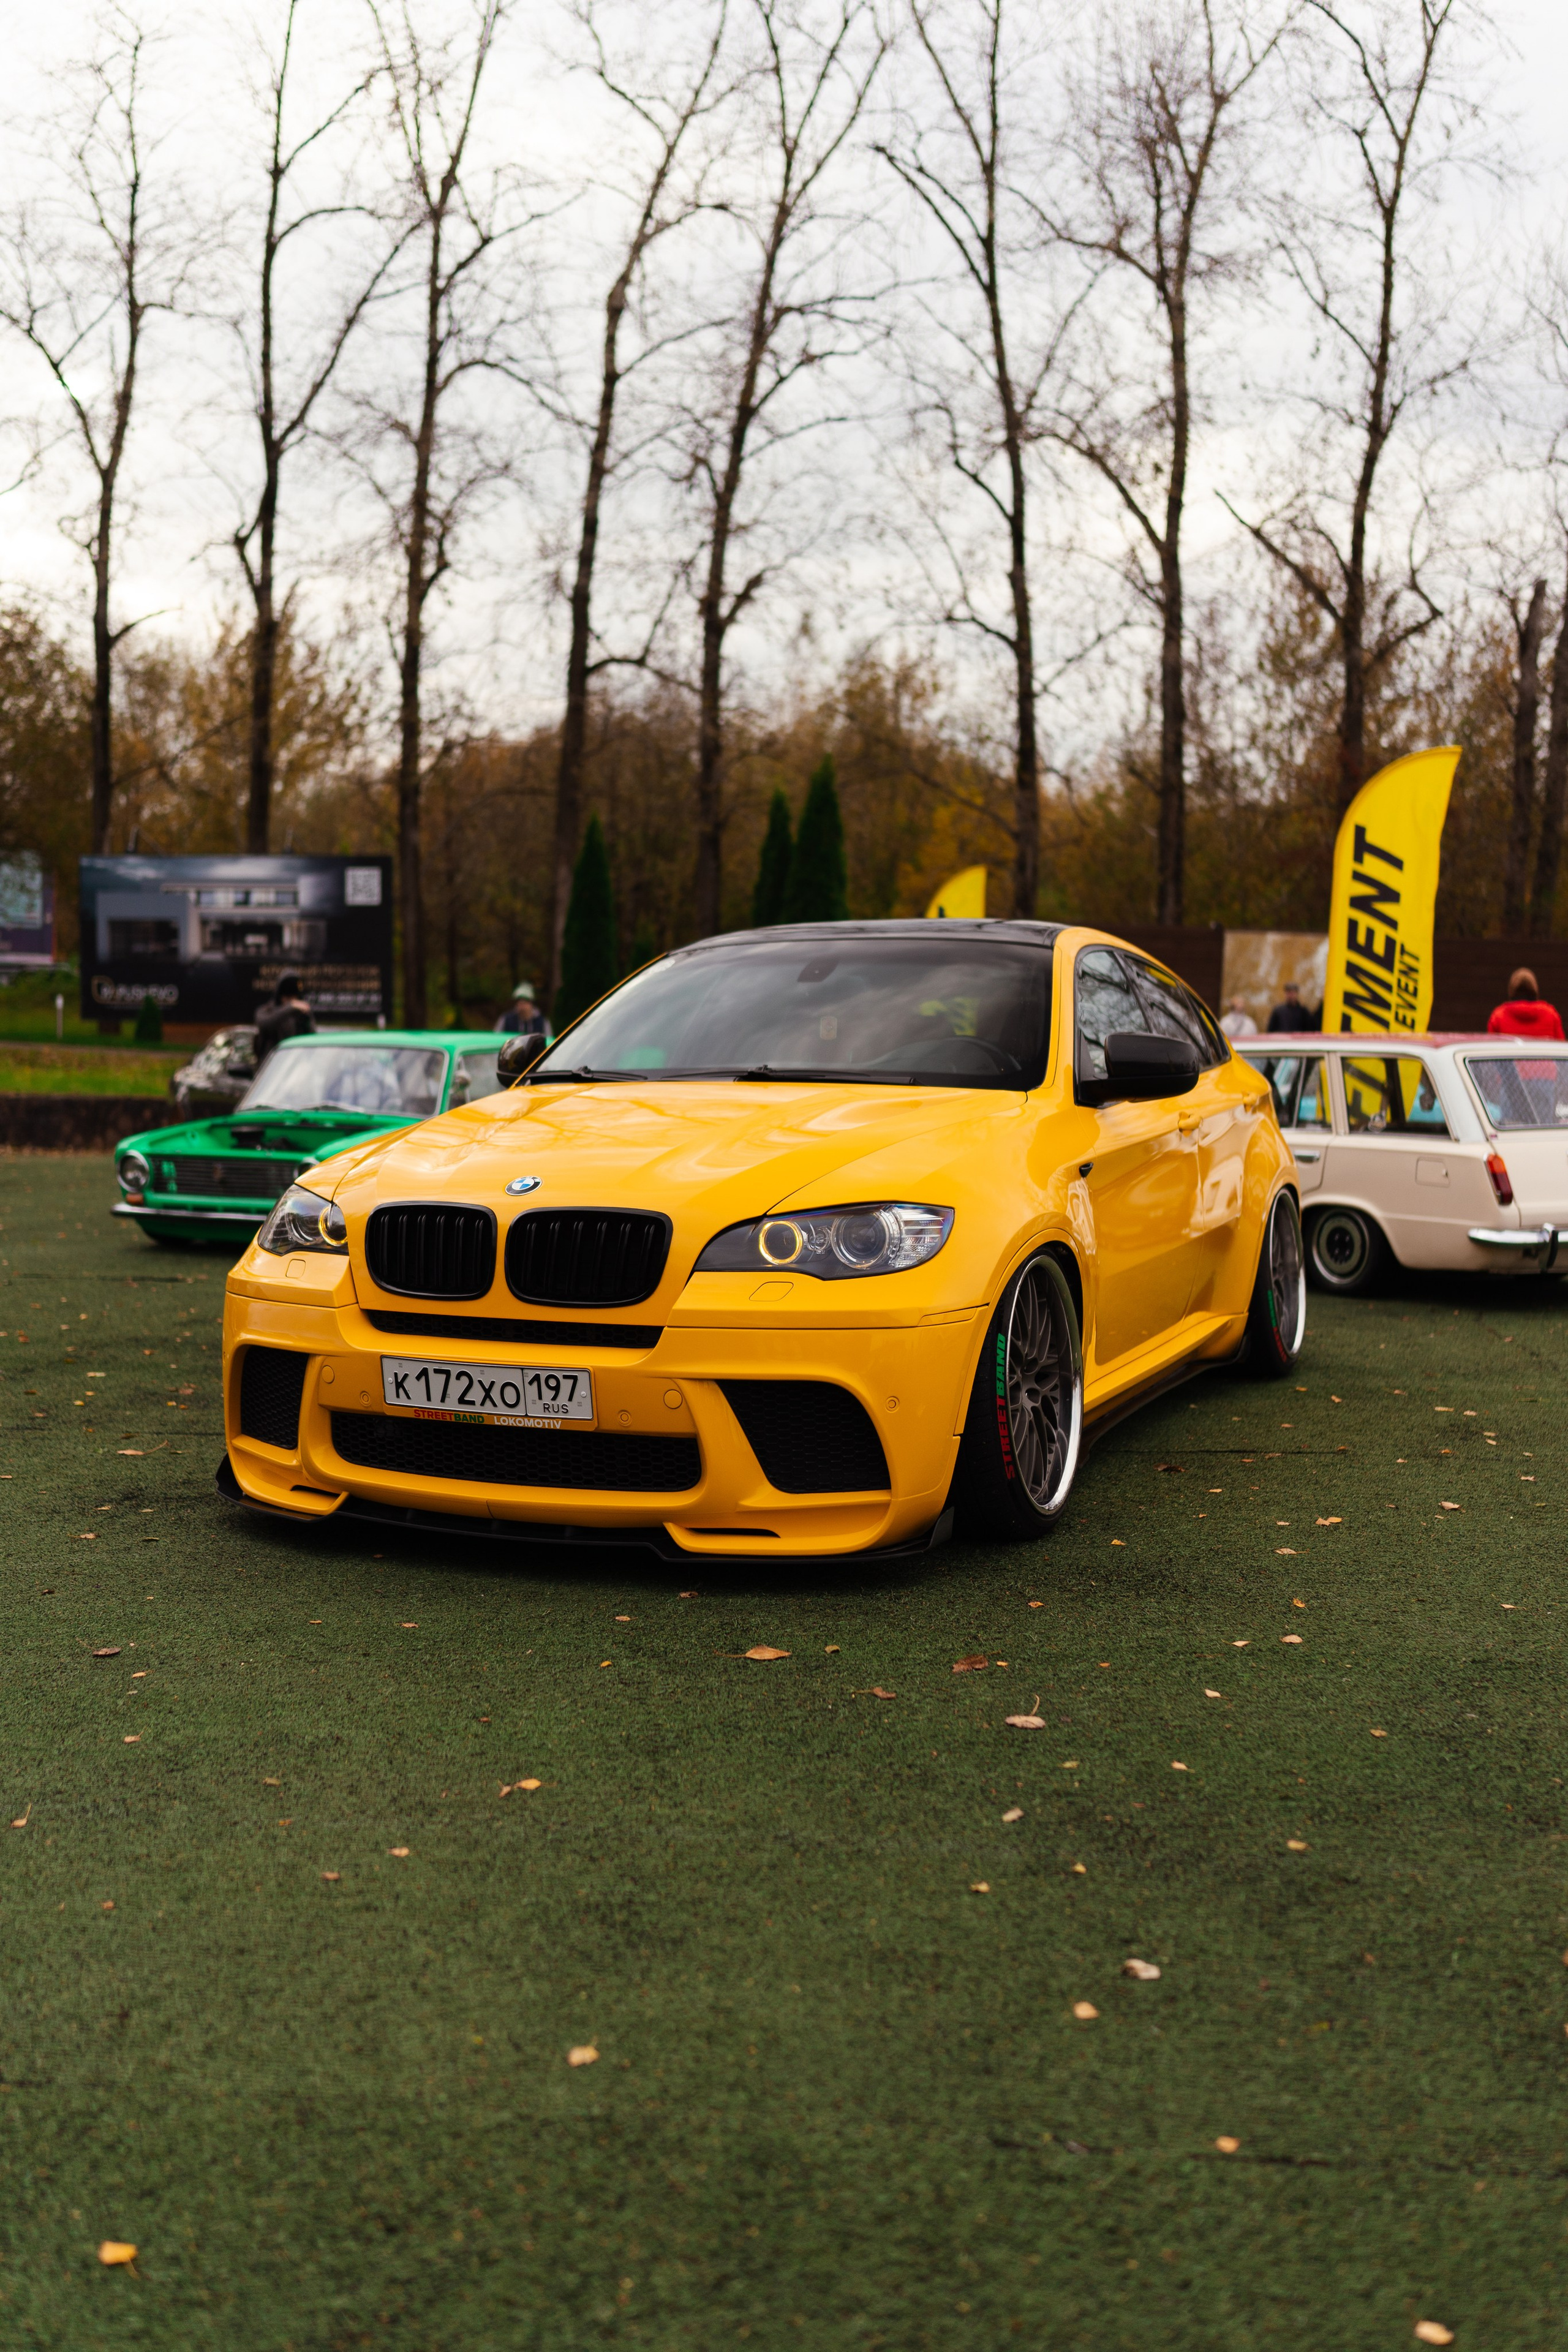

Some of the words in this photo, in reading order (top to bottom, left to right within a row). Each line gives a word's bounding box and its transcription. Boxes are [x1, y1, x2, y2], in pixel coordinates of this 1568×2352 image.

[1395, 943, 1420, 1031] EVENT
[528, 1373, 578, 1402] 197
[414, 1409, 484, 1424] STREETBAND
[494, 1416, 562, 1429] LOKOMOTIV
[543, 1402, 569, 1414] RUS
[996, 1332, 1015, 1480] STREETBAND
